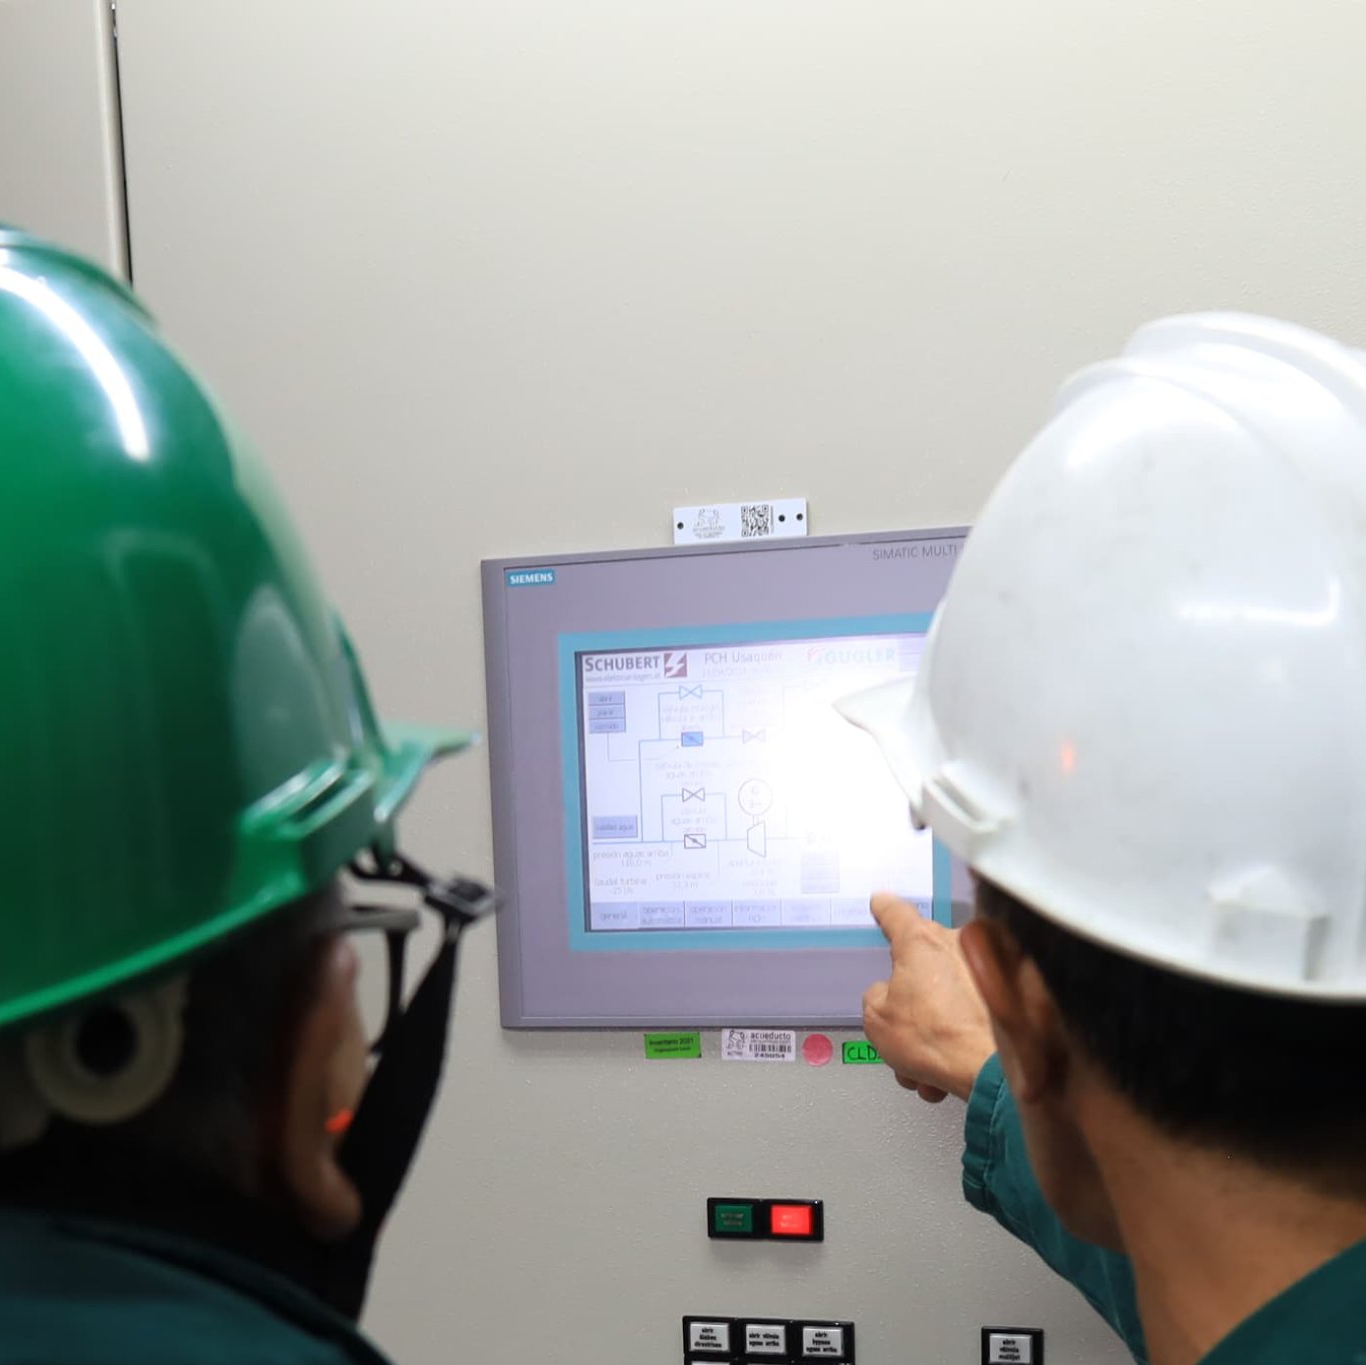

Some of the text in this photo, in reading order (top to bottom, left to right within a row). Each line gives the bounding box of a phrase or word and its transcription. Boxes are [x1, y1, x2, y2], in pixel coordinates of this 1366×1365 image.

[873, 544, 957, 561] SIMATIC MULTI
[509, 573, 554, 585] SIEMENS
[585, 655, 661, 672] SCHUBERT
[704, 652, 727, 665] PCH
[750, 1032, 791, 1040] acueducto
[847, 1044, 881, 1061] CLD
